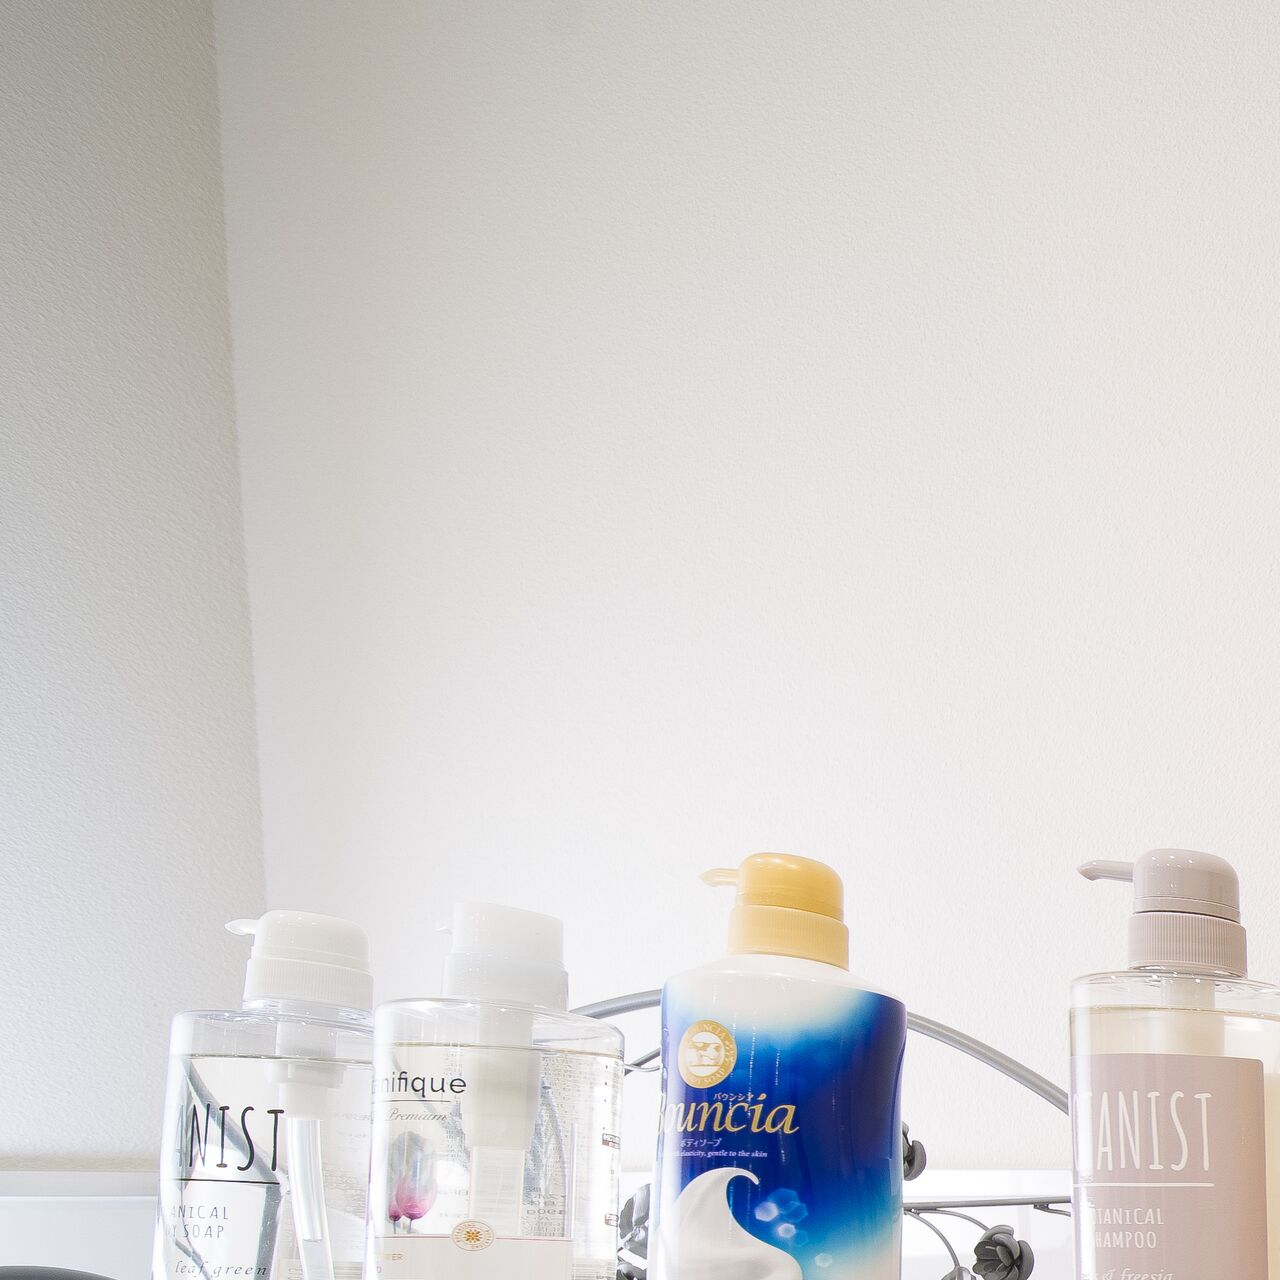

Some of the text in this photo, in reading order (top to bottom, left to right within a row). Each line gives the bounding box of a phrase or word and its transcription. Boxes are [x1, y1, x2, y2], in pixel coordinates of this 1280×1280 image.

[380, 1071, 467, 1098] nifique
[1080, 1090, 1214, 1171] ANIST
[171, 1204, 230, 1220] ANICAL
[183, 1223, 225, 1239] SOAP
[213, 1266, 268, 1279] green
